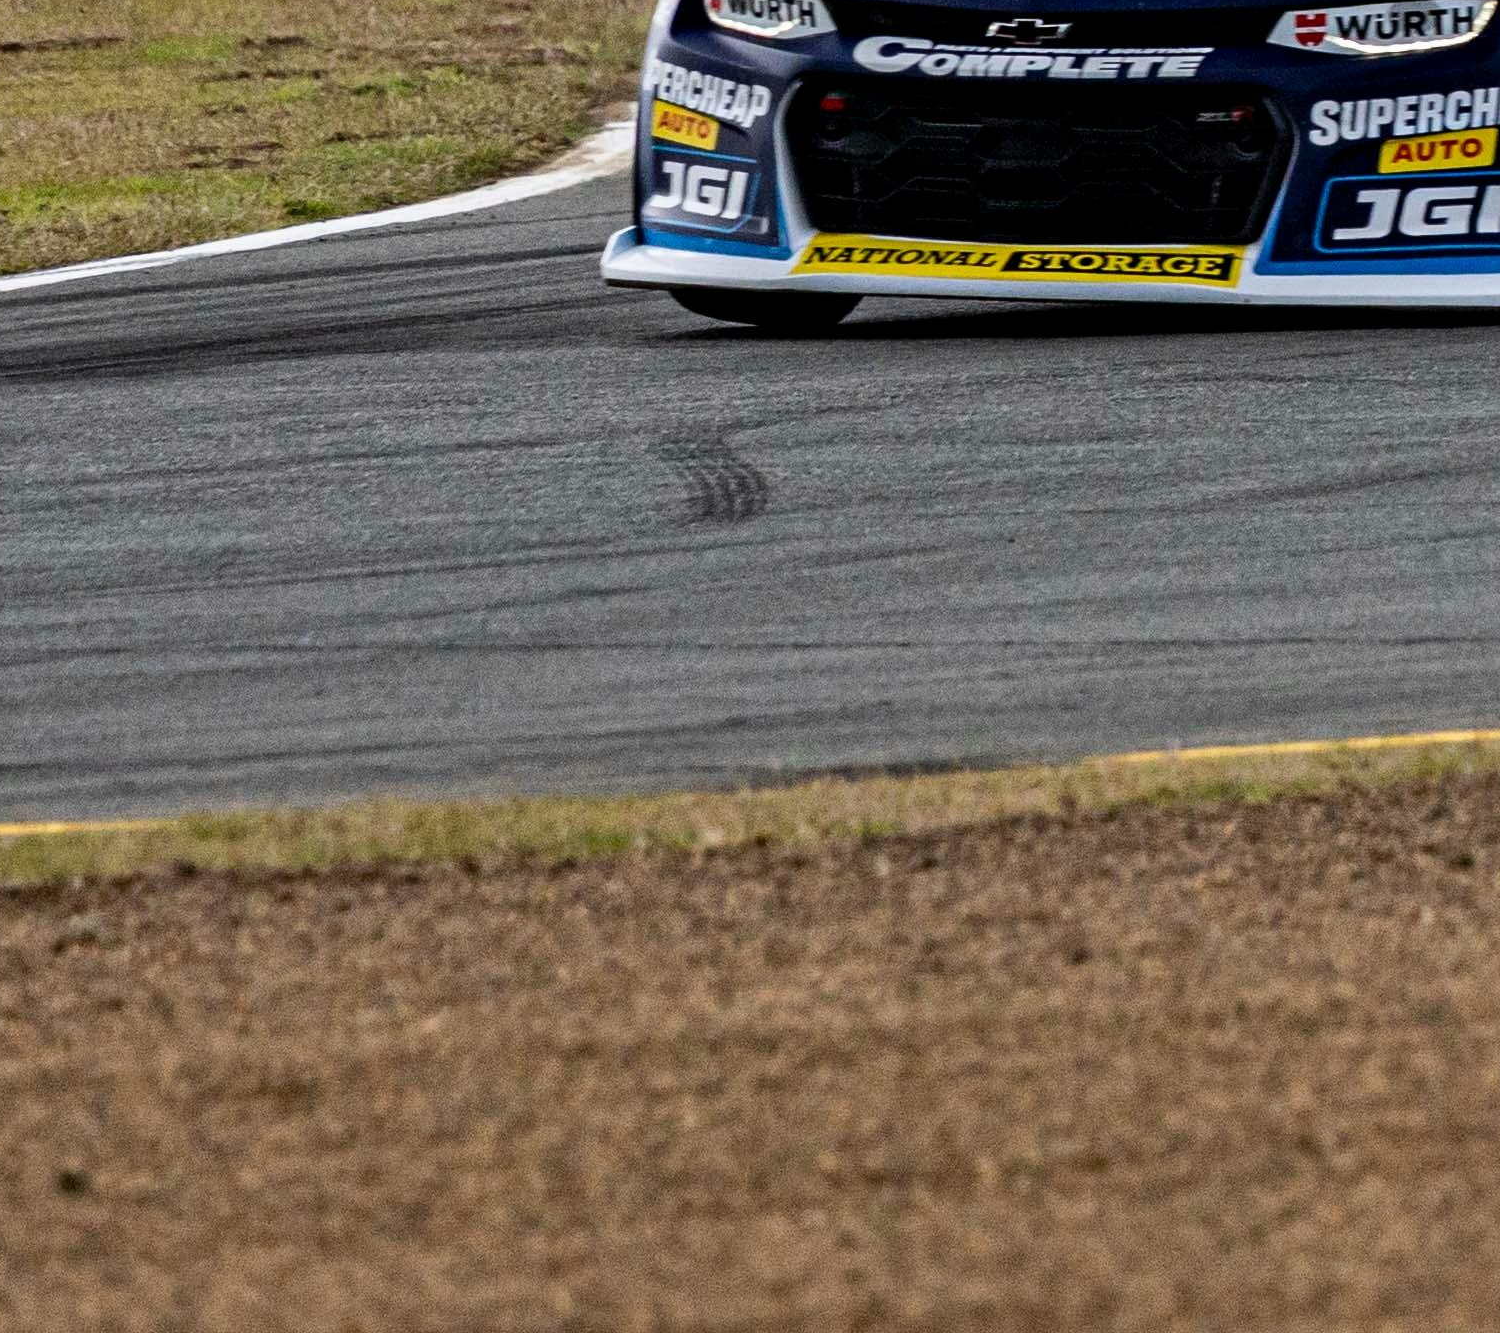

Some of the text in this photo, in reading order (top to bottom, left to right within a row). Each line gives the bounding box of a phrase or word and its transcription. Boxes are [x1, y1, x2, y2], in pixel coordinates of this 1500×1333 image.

[1335, 5, 1475, 40] WÜRTH
[852, 35, 1207, 79] COMPLETE
[657, 109, 712, 140] AUTO
[1391, 137, 1483, 164] AUTO
[649, 160, 750, 220] JGI
[804, 239, 1230, 278] NATIONAL STORAGE
